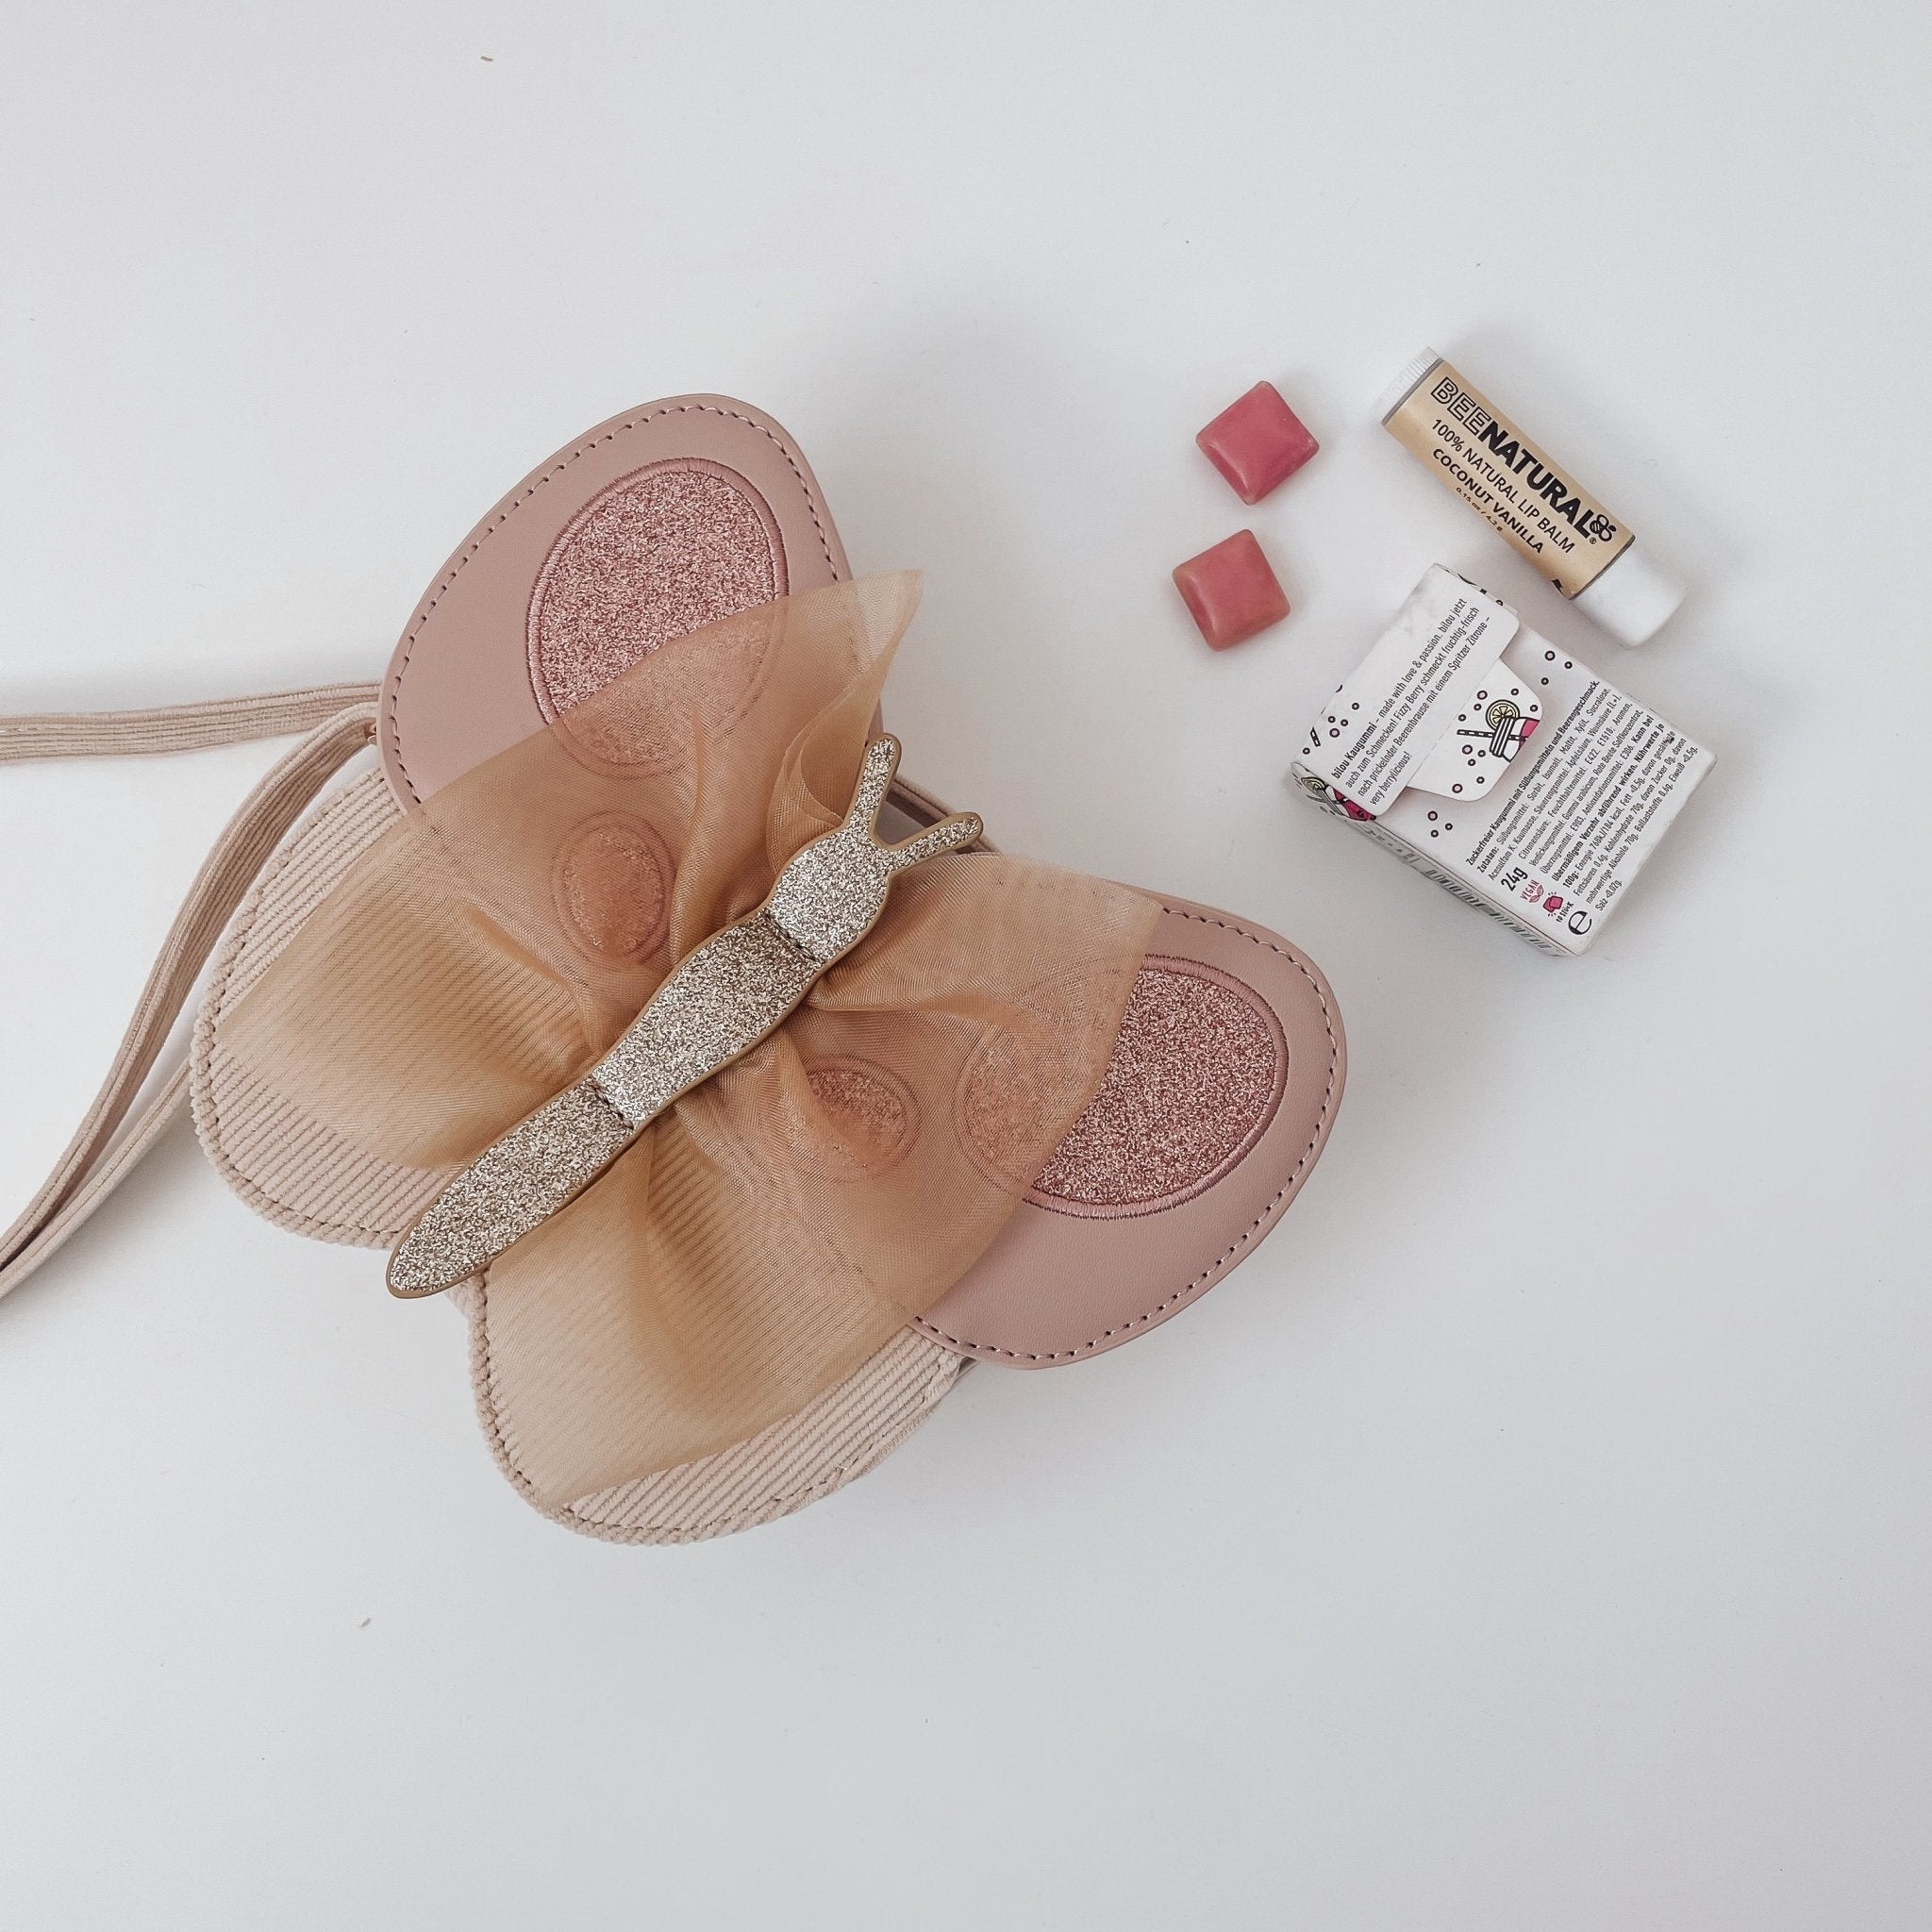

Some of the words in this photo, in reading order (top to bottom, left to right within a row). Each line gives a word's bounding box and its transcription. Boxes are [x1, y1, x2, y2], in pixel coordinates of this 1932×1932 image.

[1432, 419, 1465, 453] 100%
[1461, 447, 1519, 505] NATURAL
[1517, 498, 1541, 519] LIP
[1536, 516, 1575, 554] BALM
[1432, 448, 1494, 505] COCONUT
[1492, 501, 1544, 554] VANILLA
[1456, 487, 1473, 503] 0.15
[1330, 759, 1351, 779] bilou
[1343, 721, 1378, 761] Kaugummi
[1377, 697, 1396, 719] made
[1391, 682, 1407, 699] with
[1400, 667, 1418, 684] love
[1411, 659, 1424, 669] &
[1437, 614, 1457, 634] bilou
[1451, 598, 1468, 618] jetzt
[1344, 771, 1361, 789] auch
[1357, 757, 1372, 773] zum
[1365, 718, 1399, 758] Schmecken!
[1392, 702, 1412, 721] Fizzy
[1405, 684, 1425, 705] Berry
[1420, 652, 1447, 687] schmeckt
[1441, 607, 1480, 655] fruchtig-frisch
[1357, 779, 1374, 797] nach
[1369, 744, 1399, 783] prickelnder
[1392, 702, 1430, 747] Beerenbrause
[1425, 690, 1439, 704] mit
[1434, 669, 1454, 691] einem
[1447, 643, 1472, 672] Spritzer
[1464, 622, 1488, 647] Zitrone
[1630, 726, 1647, 744] Kann
[1641, 714, 1655, 727] bei
[1369, 789, 1386, 806] very
[1377, 750, 1411, 792] berrylicious!
[1465, 828, 1495, 866] Zuckerfreier
[1489, 797, 1517, 832] Kaugummi
[1511, 788, 1524, 802] mit
[1518, 743, 1556, 791] Süßungsmitteln
[1551, 731, 1563, 746] und
[1557, 680, 1601, 735] Beerengeschmack.
[1488, 850, 1513, 881] Acesulfam
[1587, 708, 1612, 738] Weinsäure
[1561, 799, 1580, 821] Gummi
[1591, 761, 1607, 776] Rote
[1600, 746, 1618, 764] Beete
[1562, 870, 1580, 889] 100g:
[1574, 849, 1594, 872] Energie
[1619, 792, 1633, 807] Fett
[1641, 758, 1657, 776] davon
[1573, 867, 1598, 897] Fettsäuren
[1603, 814, 1635, 854] Kohlenhydrate
[1640, 783, 1656, 802] davon
[1650, 764, 1669, 785] Zucker
[1671, 738, 1688, 756] davon
[1578, 816, 1601, 841] Verzehr
[1597, 784, 1623, 818] abführend
[1618, 764, 1639, 787] wirken.
[1633, 730, 1660, 763] Nährwerte
[1655, 723, 1665, 734] je
[1476, 846, 1500, 874] Zutaten:
[1500, 866, 1528, 892] 24g
[1585, 869, 1613, 905] mehrwertige
[1607, 844, 1629, 871] Alkohole
[1633, 796, 1663, 833] Ballaststoffe
[1667, 761, 1686, 783] Eiweiß
[1520, 878, 1541, 901] VEGAN
[1555, 915, 1564, 924] 10
[1594, 897, 1609, 912] Salz
